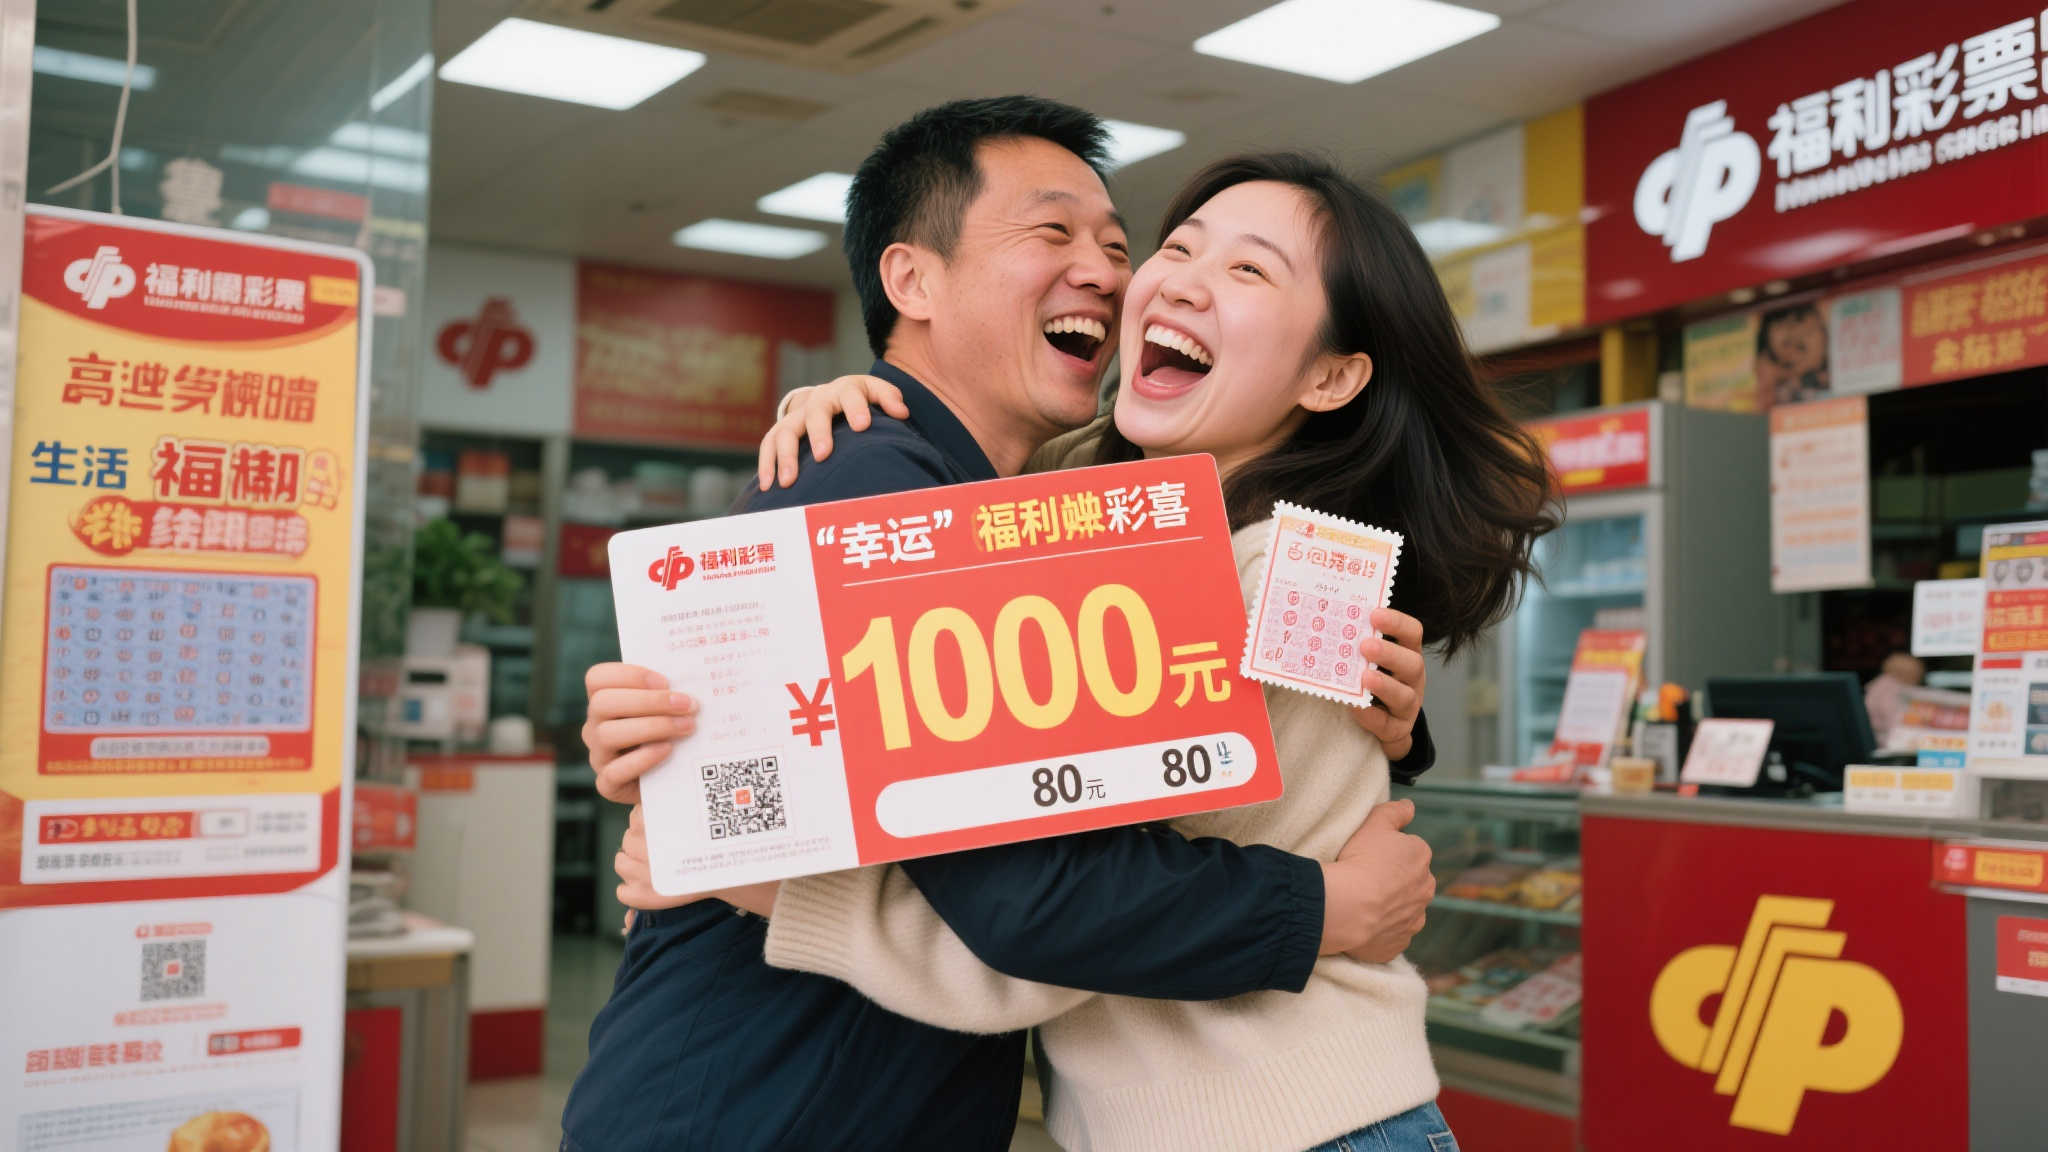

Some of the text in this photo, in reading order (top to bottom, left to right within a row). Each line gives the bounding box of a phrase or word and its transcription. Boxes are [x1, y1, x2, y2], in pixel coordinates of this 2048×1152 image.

[1767, 8, 2048, 178] 福利彩票
[30, 441, 129, 490] 生活
